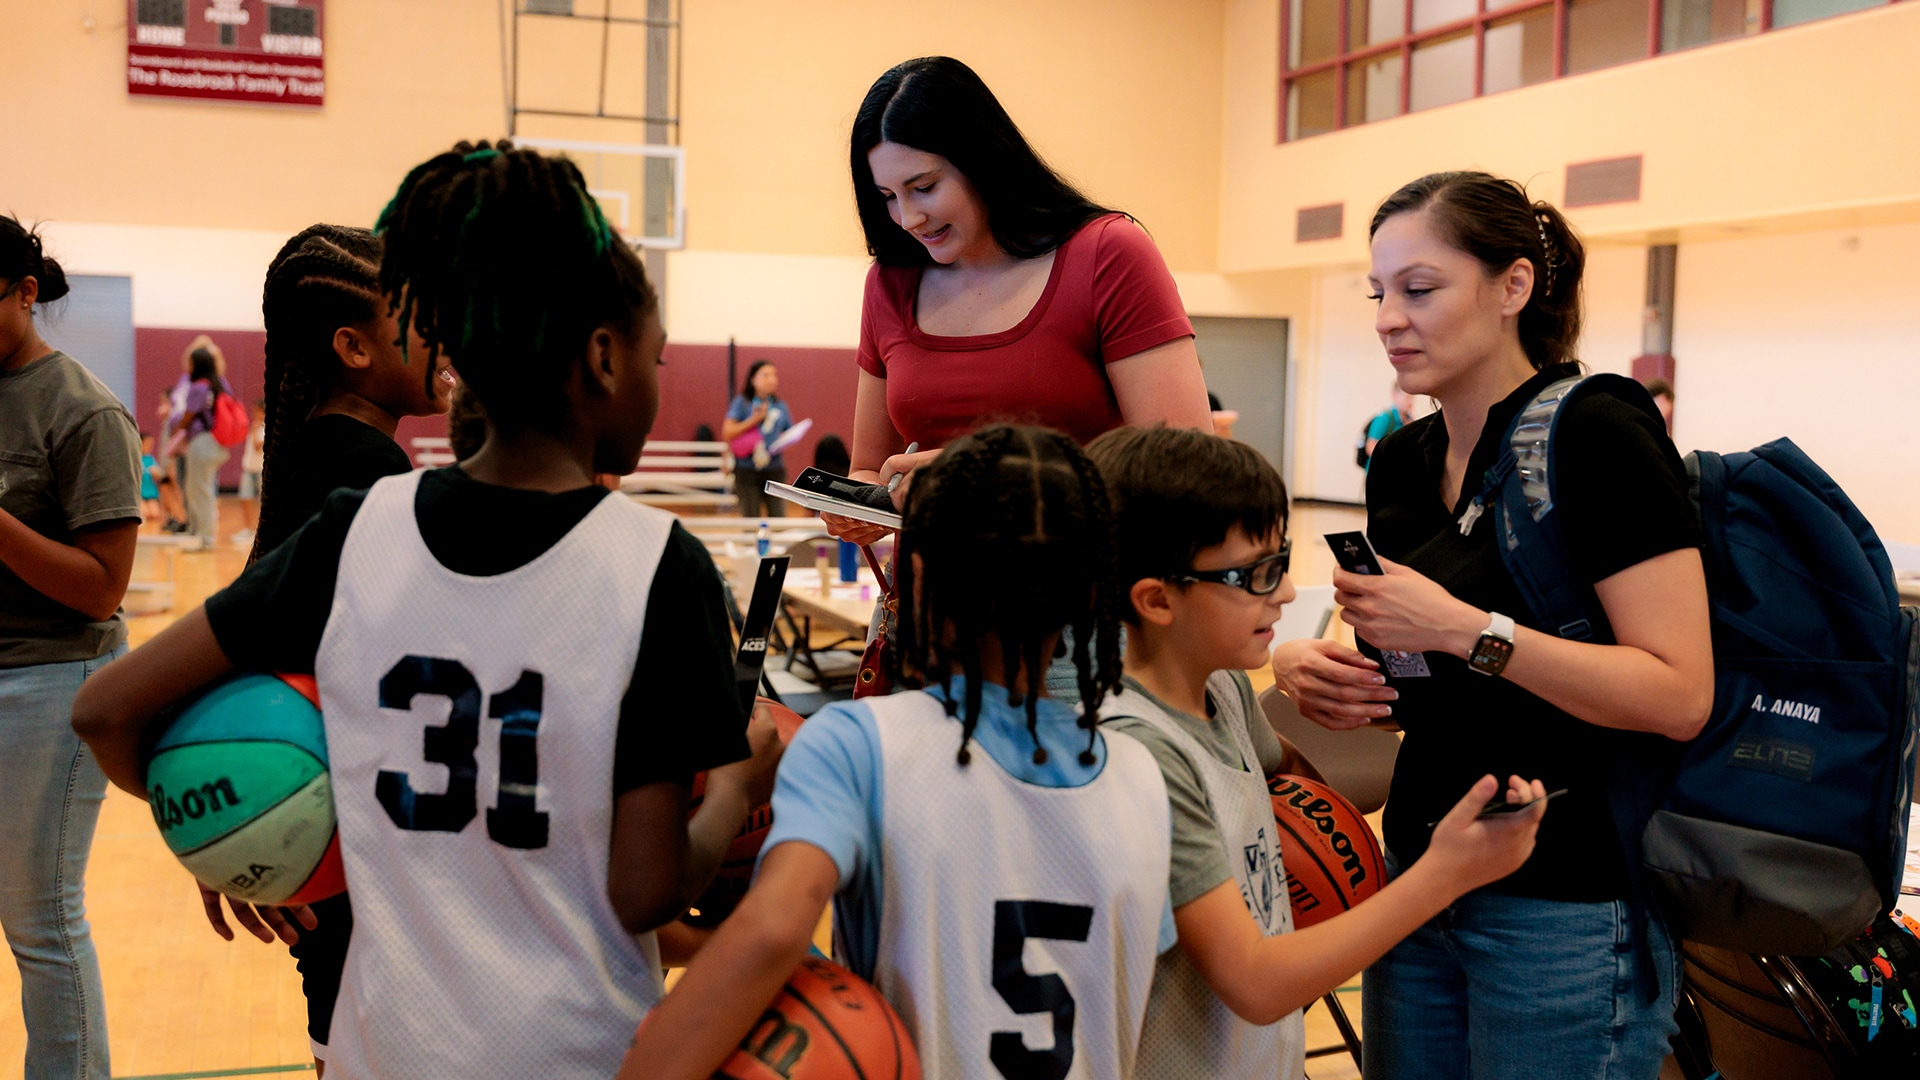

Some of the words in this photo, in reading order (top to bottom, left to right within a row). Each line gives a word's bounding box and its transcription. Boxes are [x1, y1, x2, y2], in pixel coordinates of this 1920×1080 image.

[136, 25, 185, 46] HOME
[260, 34, 322, 56] VISITOR
[129, 66, 157, 87] The
[158, 69, 235, 91] Rosebrock
[237, 74, 287, 97] Family
[741, 640, 766, 652] ACES
[1751, 694, 1766, 712] A.
[1770, 699, 1820, 724] ANAYA
[376, 654, 549, 849] 31
[153, 775, 240, 830] lson
[989, 899, 1094, 1080] 5
